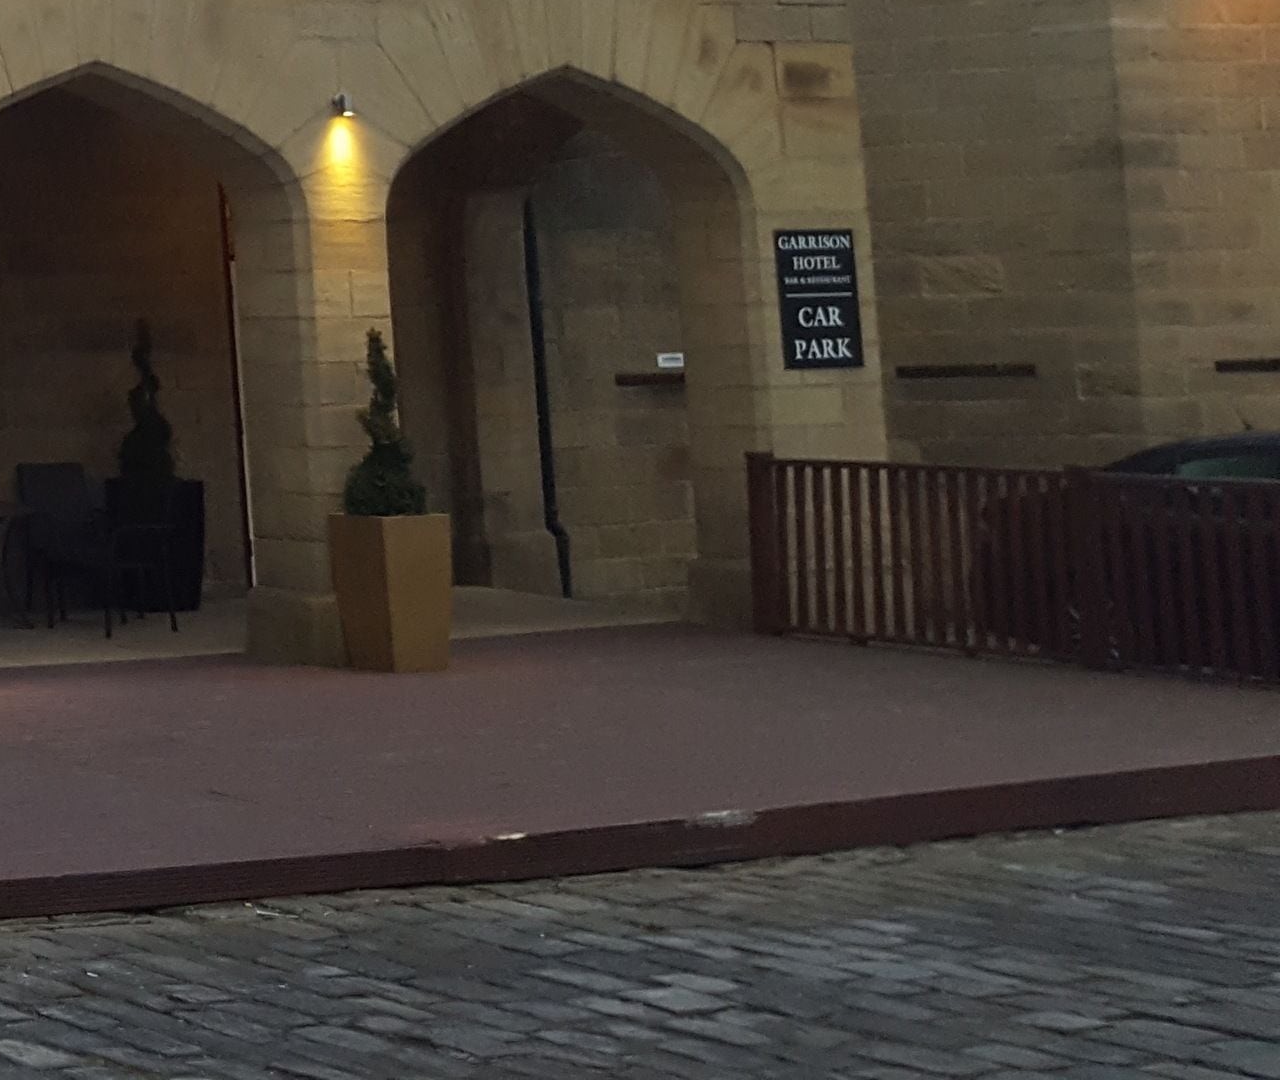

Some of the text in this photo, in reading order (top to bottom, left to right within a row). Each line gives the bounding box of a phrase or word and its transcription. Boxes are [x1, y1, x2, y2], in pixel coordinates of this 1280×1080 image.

[778, 235, 850, 250] GARRISON
[792, 256, 841, 270] HOTEL
[798, 306, 845, 328] CAR
[794, 338, 853, 360] PARK
